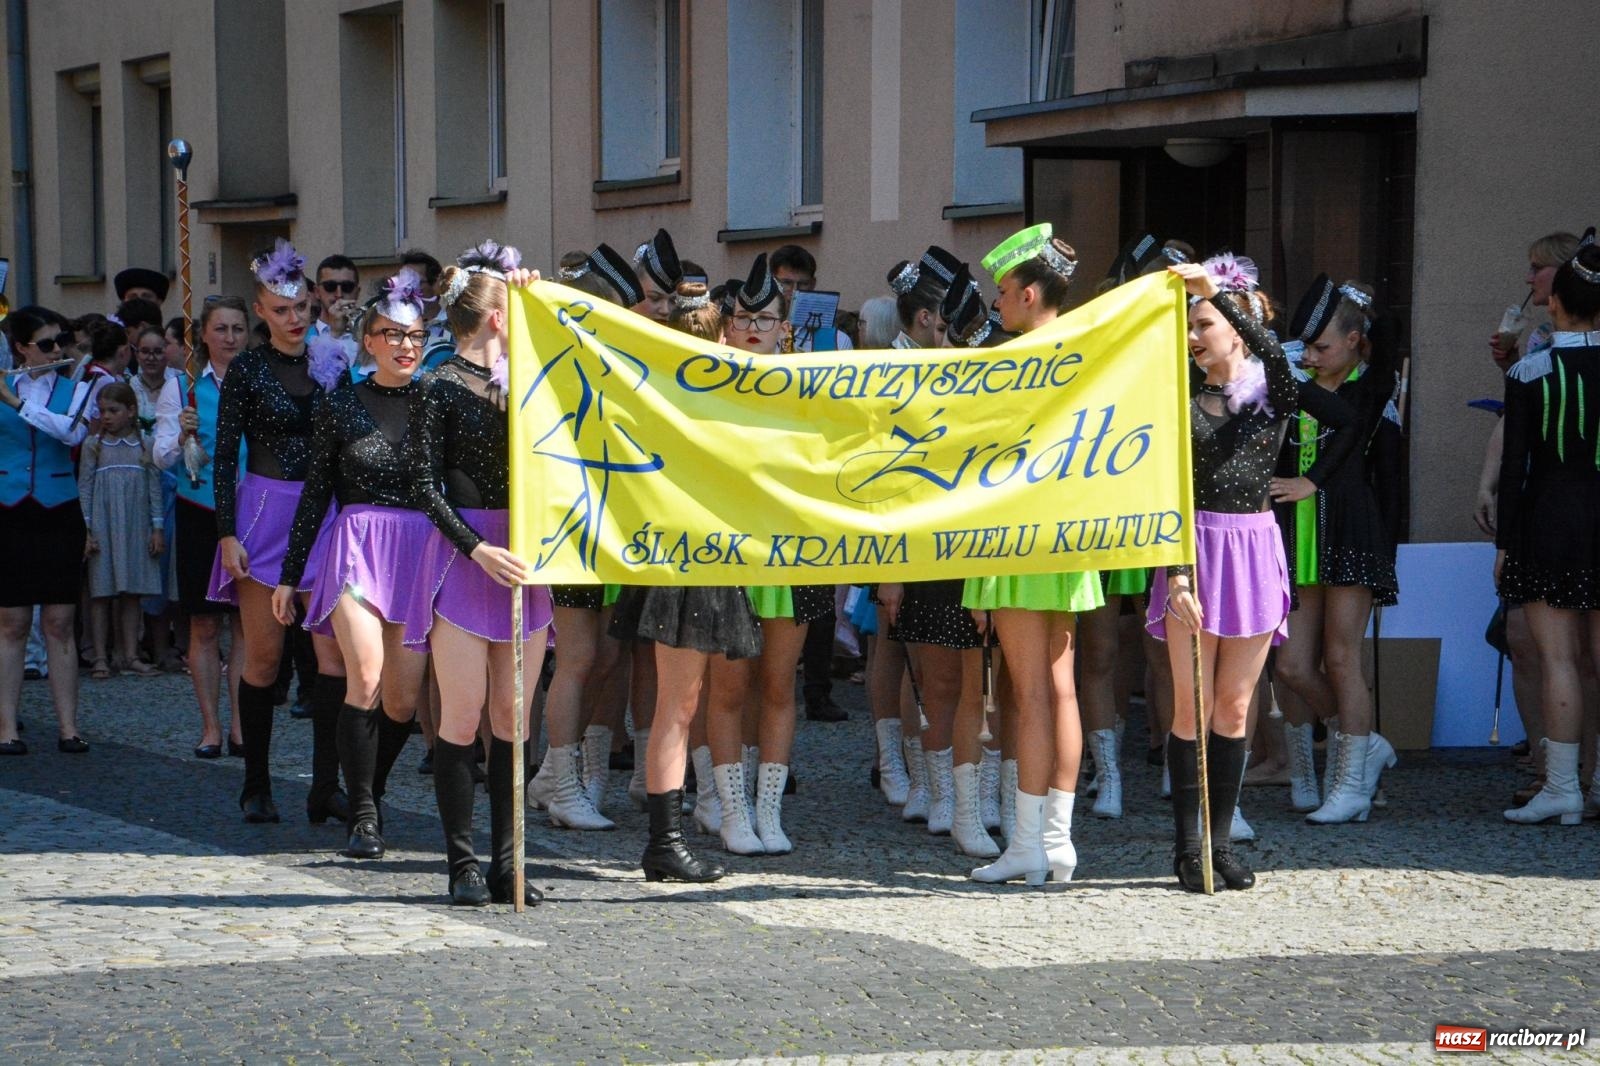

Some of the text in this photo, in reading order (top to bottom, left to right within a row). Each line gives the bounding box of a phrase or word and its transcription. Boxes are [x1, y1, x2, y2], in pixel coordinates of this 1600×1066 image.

[676, 342, 1082, 414] Stowarzyszenie
[837, 405, 1153, 503] Źródło
[622, 510, 1182, 572] ŚLĄSK KRAINA WIELU KULTUR
